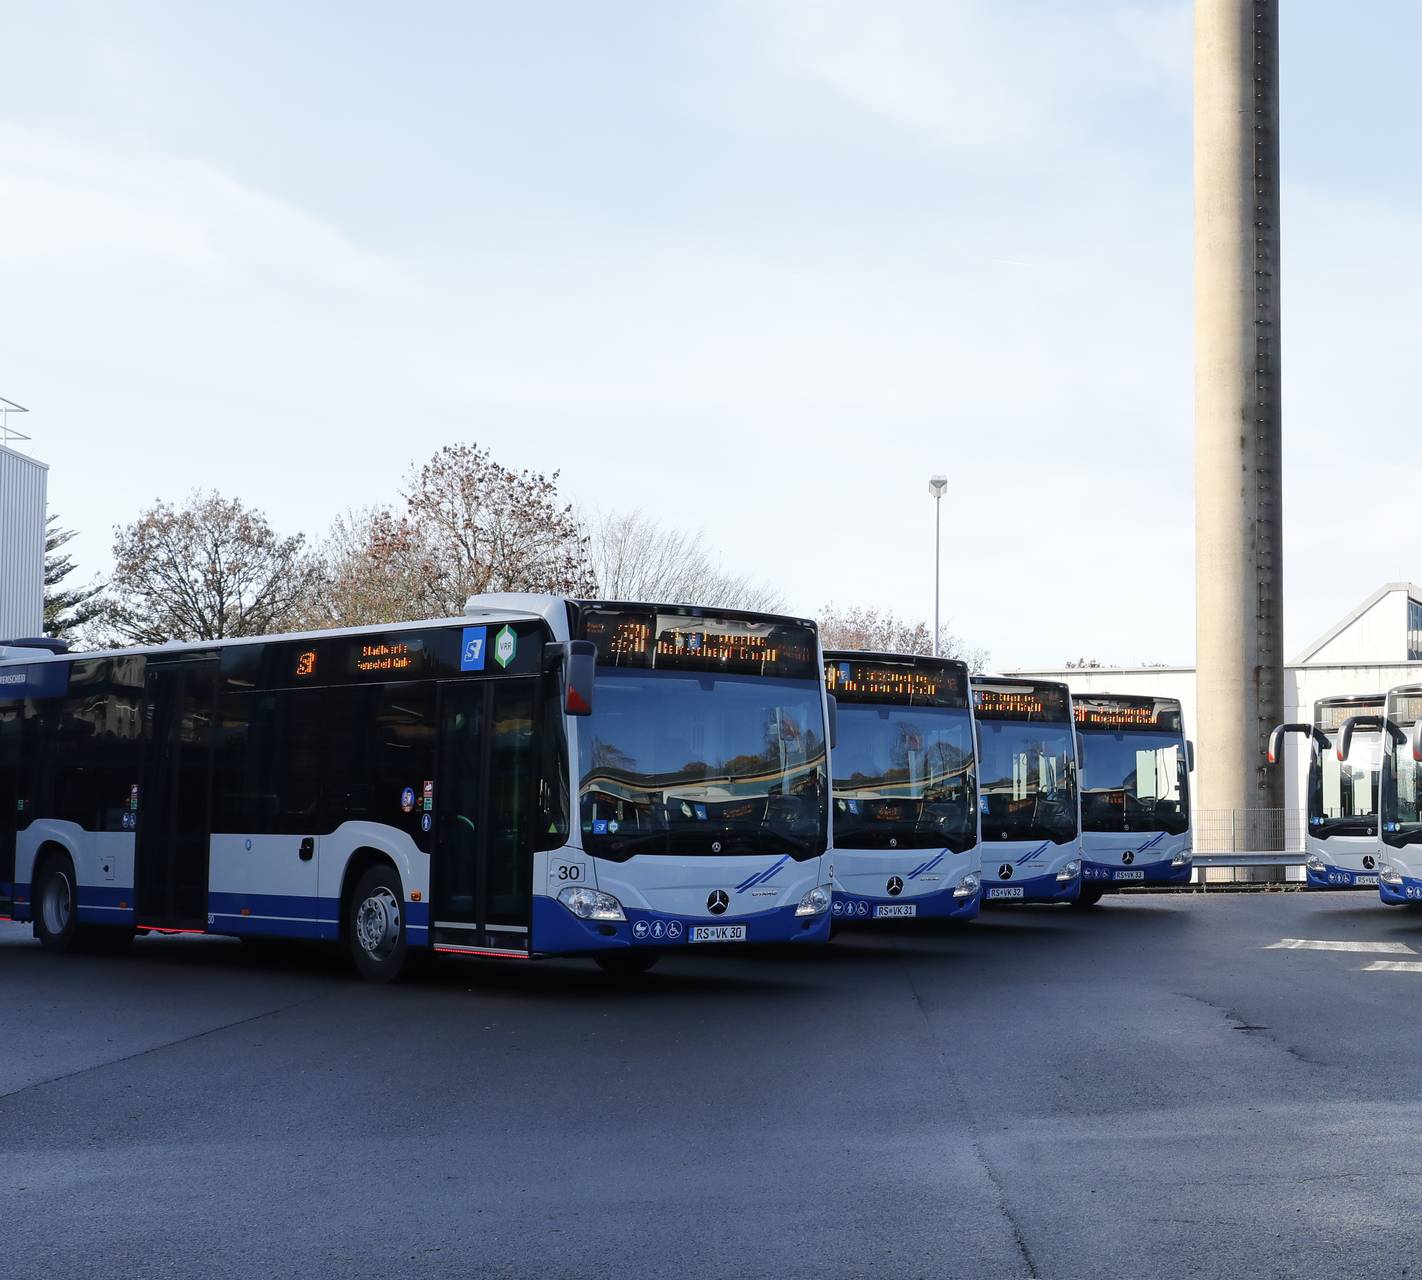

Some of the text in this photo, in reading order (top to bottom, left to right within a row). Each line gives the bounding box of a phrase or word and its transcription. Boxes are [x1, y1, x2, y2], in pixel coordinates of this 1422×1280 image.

[499, 641, 512, 651] VRR
[558, 865, 580, 880] 30
[879, 906, 913, 916] RS VK 31
[696, 927, 742, 940] RS VK 30
